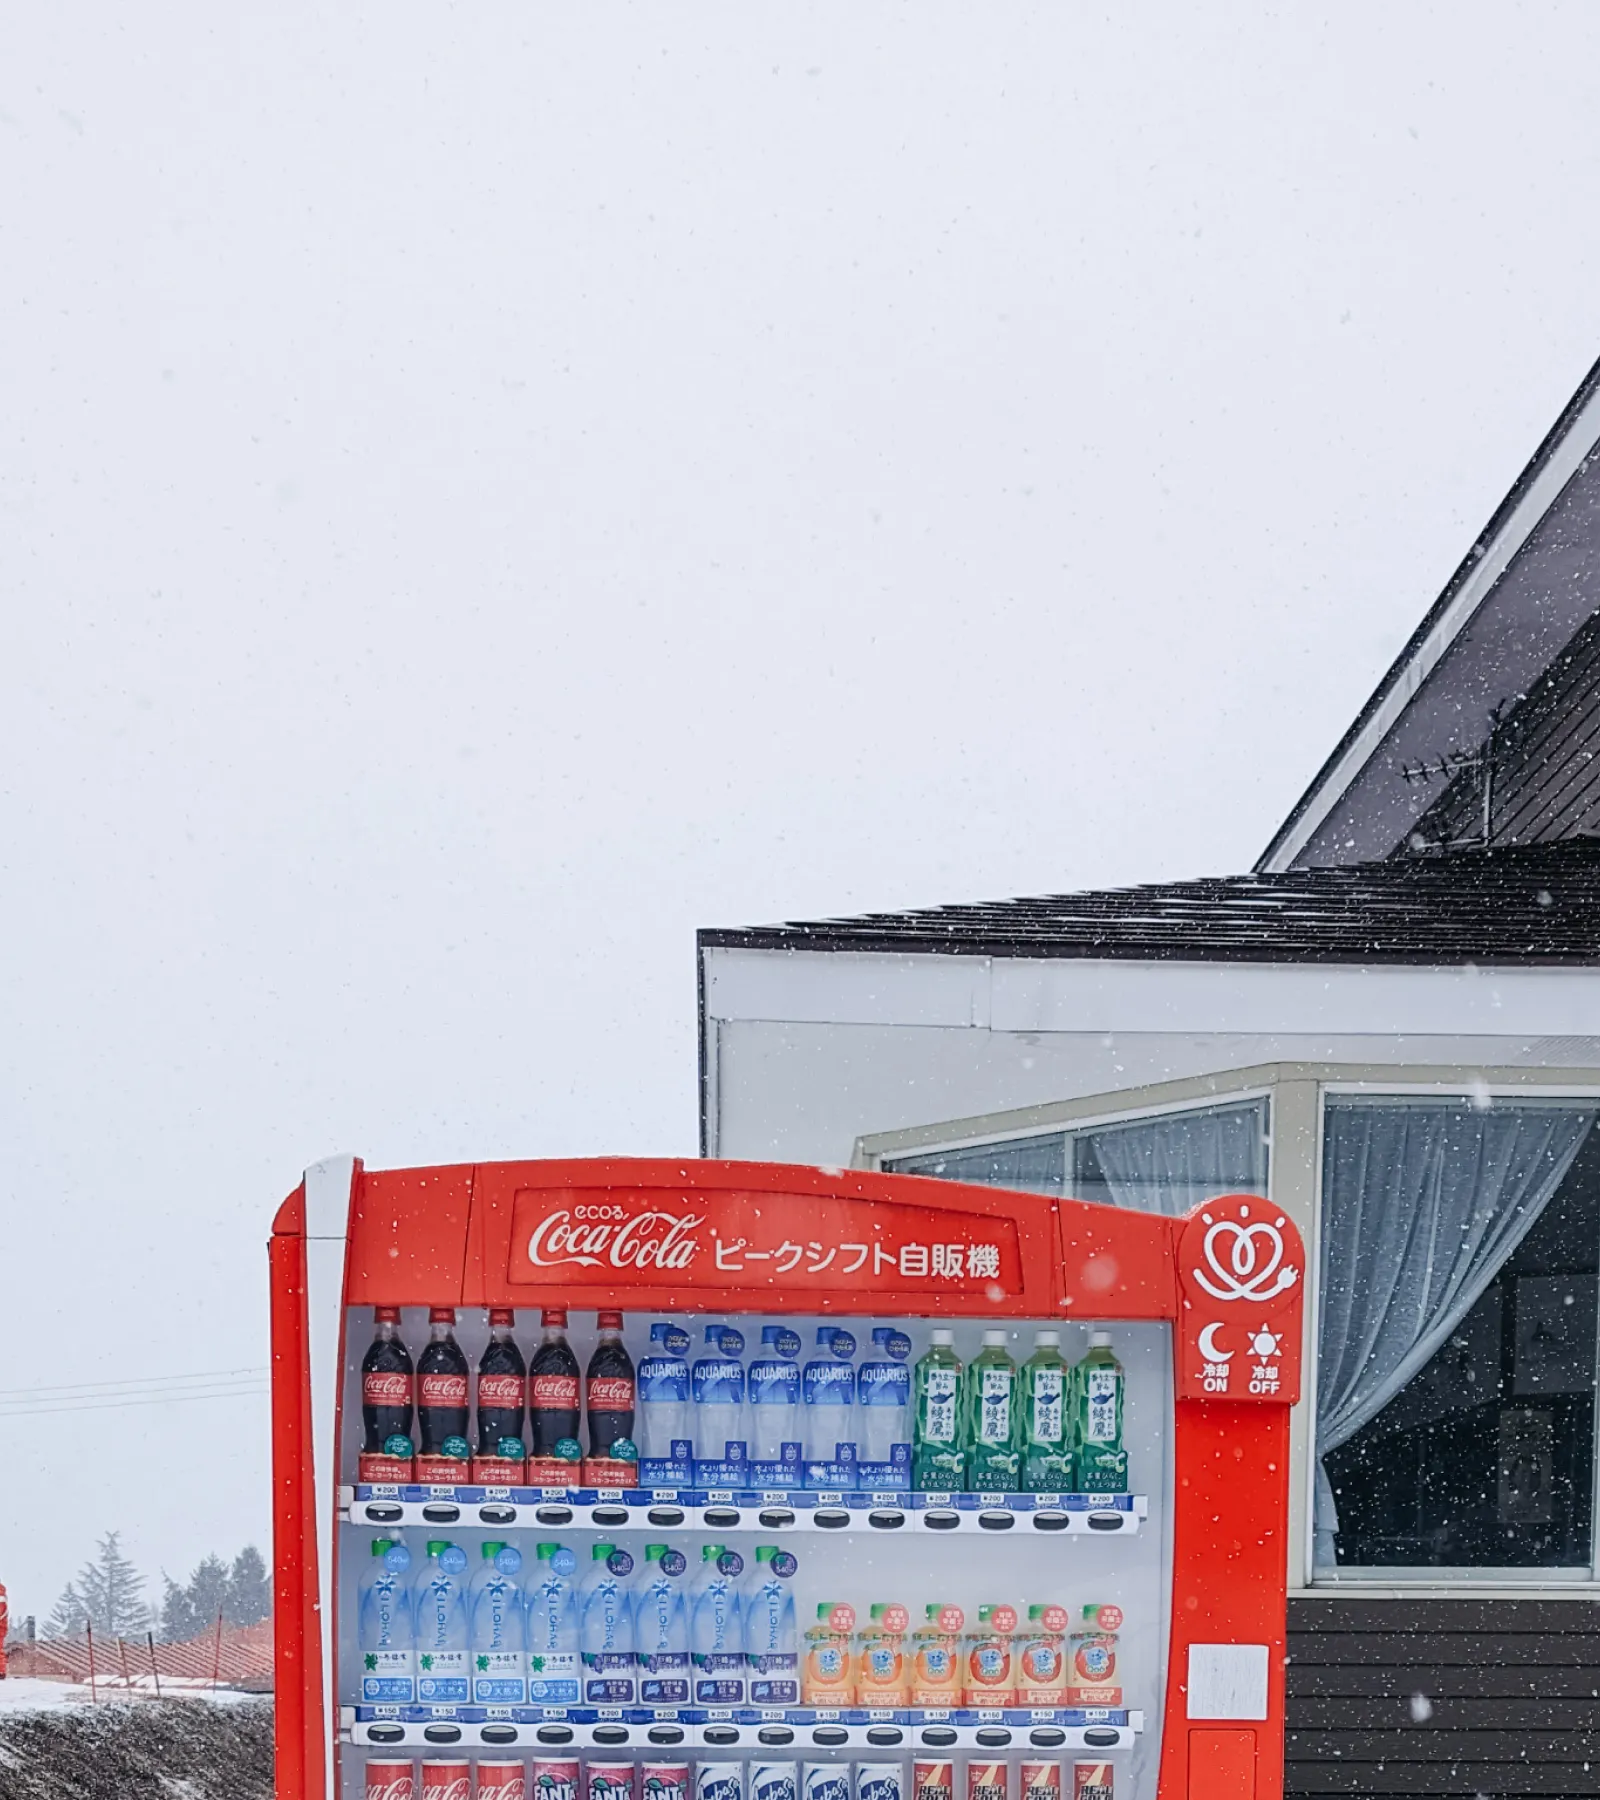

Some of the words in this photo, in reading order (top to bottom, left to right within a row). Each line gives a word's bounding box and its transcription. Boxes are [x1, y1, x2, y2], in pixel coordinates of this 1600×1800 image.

[528, 1212, 705, 1268] Coca-Cola
[716, 1237, 1000, 1279] ピークシフト自販機
[640, 1363, 687, 1378] AQUARIUS
[694, 1365, 741, 1380] AQUARIUS
[751, 1366, 798, 1381] AQUARIUS
[806, 1367, 853, 1382] AQUARIUS
[861, 1368, 908, 1382] AQUARIUS
[1202, 1363, 1229, 1378] 冷却
[1251, 1366, 1278, 1379] 冷却
[365, 1374, 406, 1394] Coca-Cola
[422, 1377, 466, 1396] Coca-Cola
[479, 1378, 521, 1396] Coca-Cola
[534, 1379, 576, 1397] Coca-Cola
[590, 1381, 632, 1399] Coca-Cola
[1203, 1378, 1228, 1392] ON
[1249, 1381, 1280, 1395] OFF
[930, 1406, 944, 1438] 綾鷹
[985, 1406, 999, 1438] 綾鷹
[1038, 1406, 1052, 1438] 綾鷹
[1092, 1406, 1106, 1438] 綾鷹
[645, 1462, 686, 1471] 水より優れた
[699, 1463, 741, 1472] 水より優れた
[754, 1464, 796, 1473] 水より優れた
[865, 1465, 905, 1474] 水より優れた
[648, 1471, 685, 1480] 水分補給
[702, 1472, 738, 1481] 水分補給
[756, 1473, 794, 1482] 水分補給
[867, 1474, 903, 1483] 水分補給
[919, 1785, 950, 1794] REAL
[974, 1785, 1005, 1794] REAL
[1027, 1786, 1059, 1795] REAL
[1081, 1785, 1113, 1794] REAL
